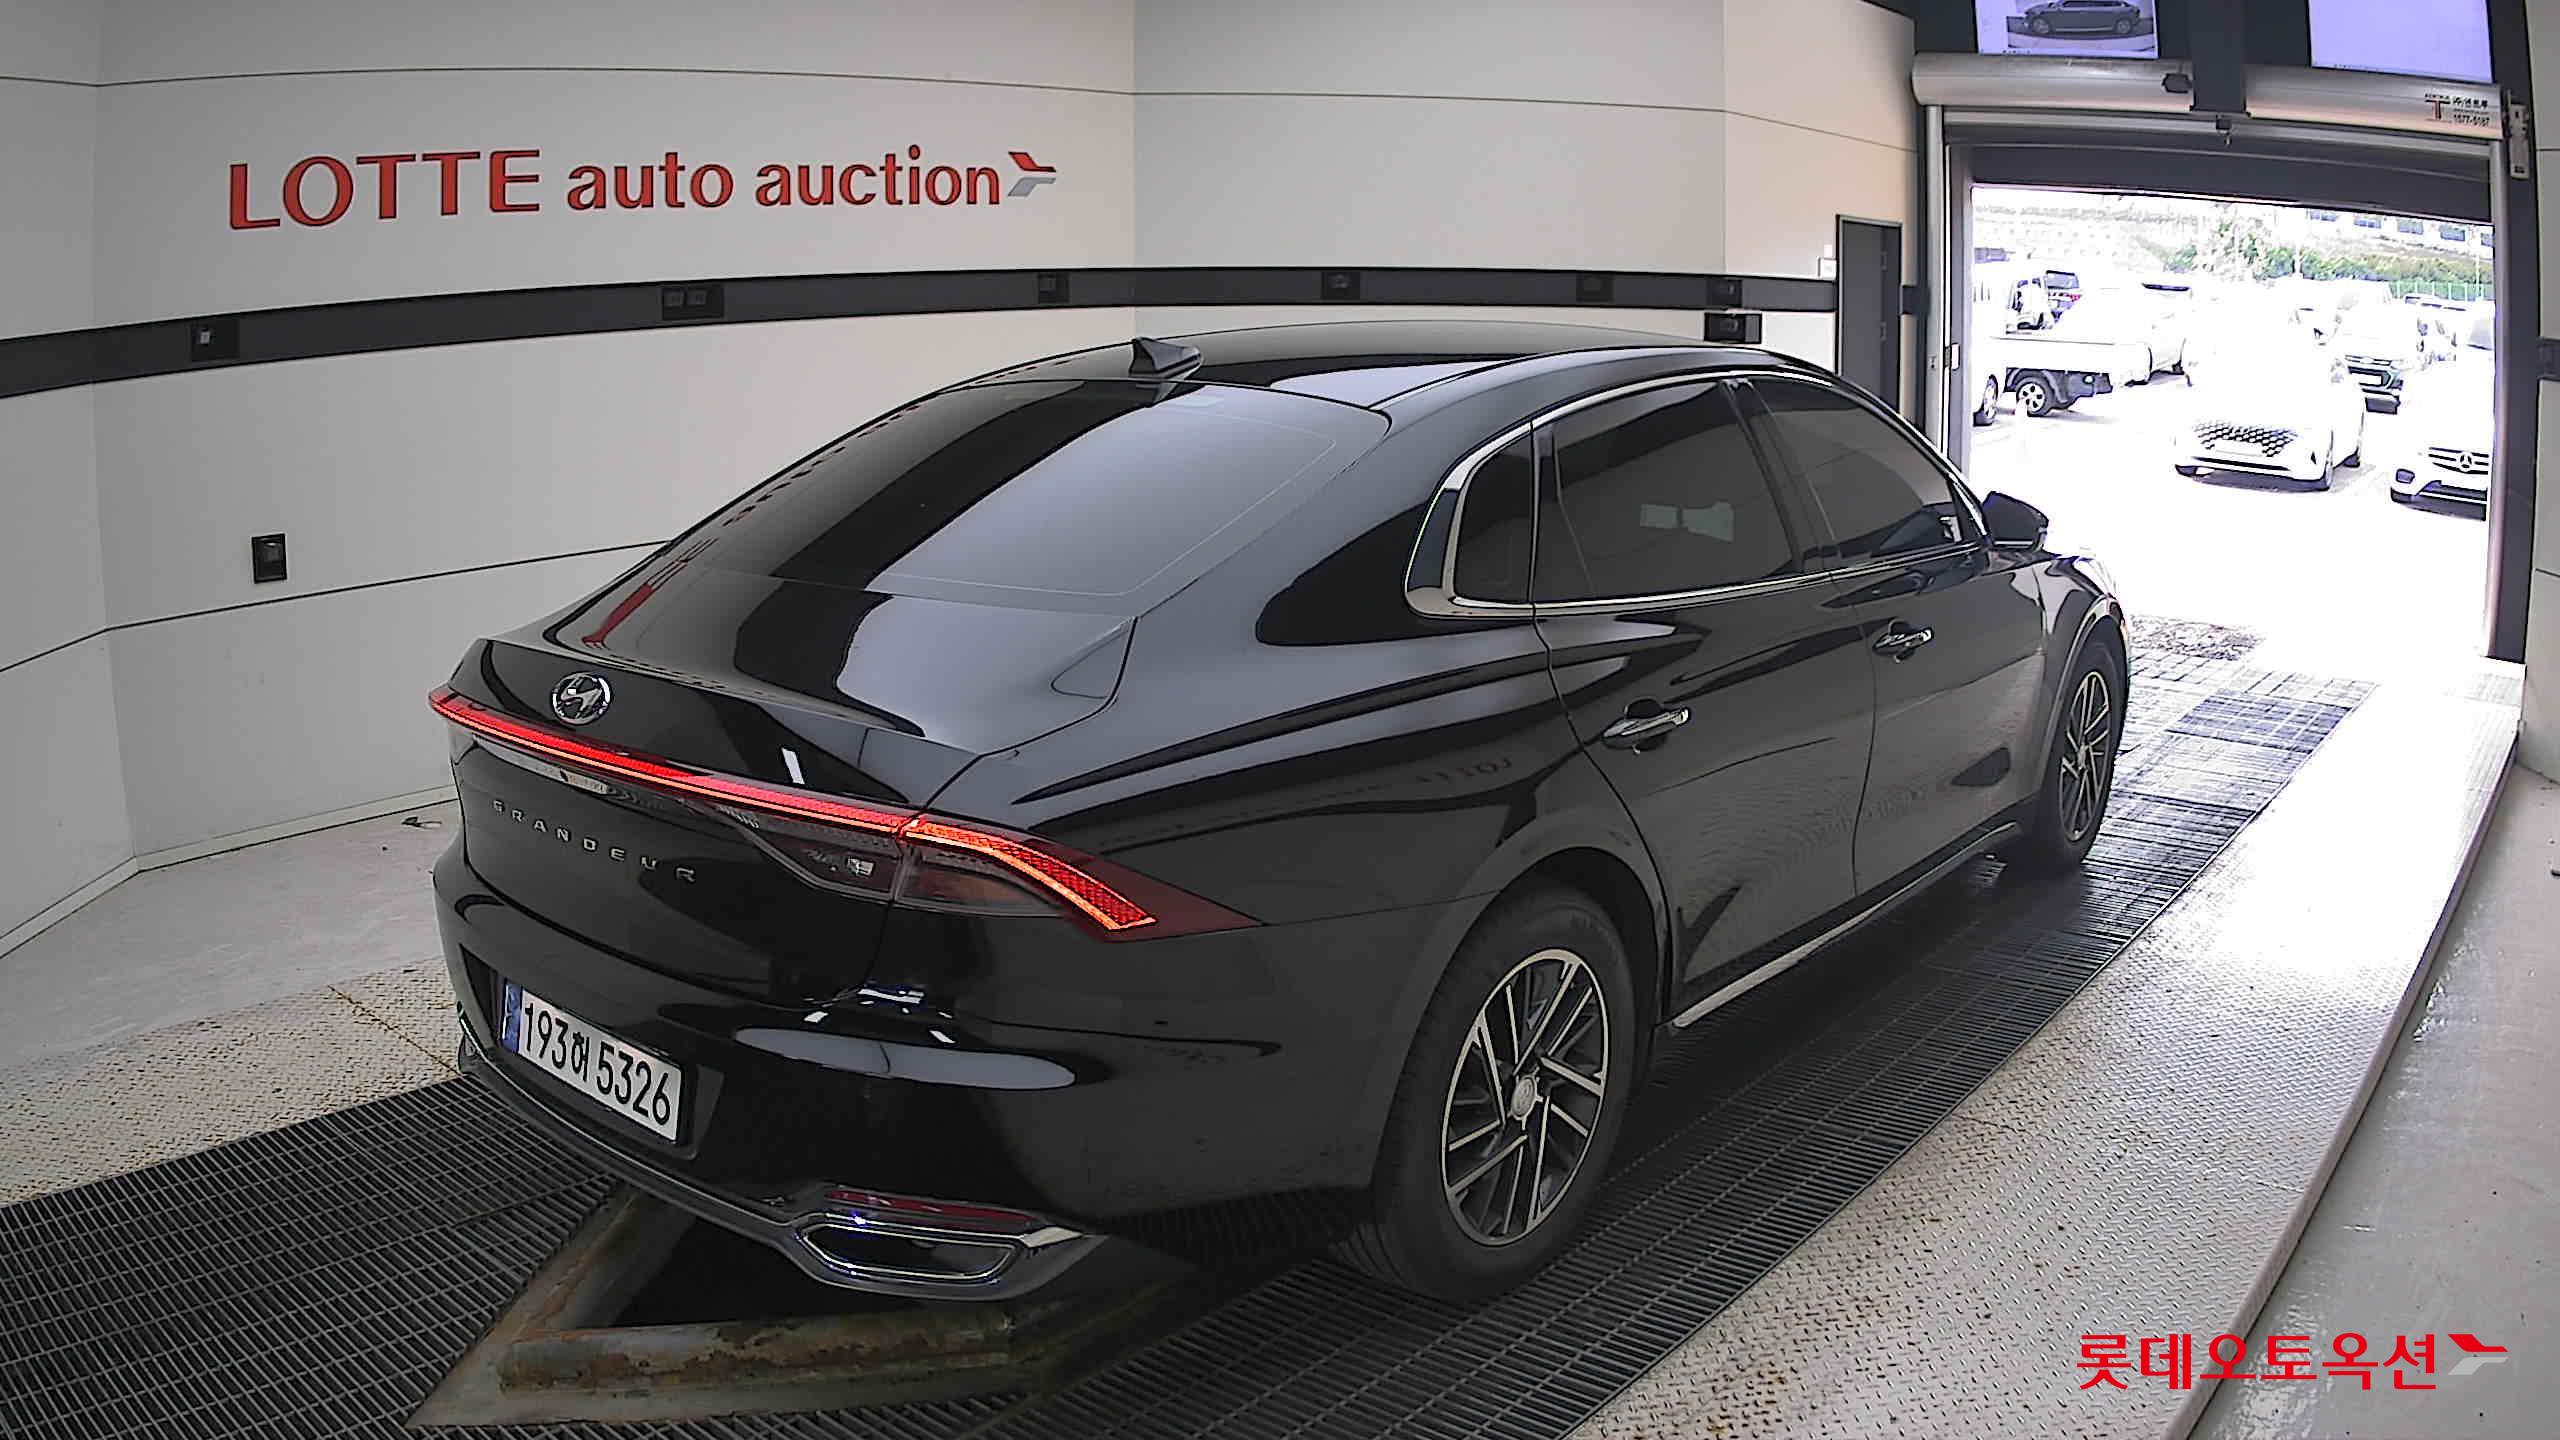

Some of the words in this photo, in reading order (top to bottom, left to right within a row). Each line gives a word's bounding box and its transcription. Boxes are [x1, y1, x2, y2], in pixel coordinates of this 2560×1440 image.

[229, 149, 540, 231] LOTTE
[567, 151, 736, 210] auto
[756, 144, 1003, 207] auction
[492, 799, 696, 883] GRANDEUR
[524, 1002, 590, 1083] 193허
[596, 1040, 671, 1126] 5326
